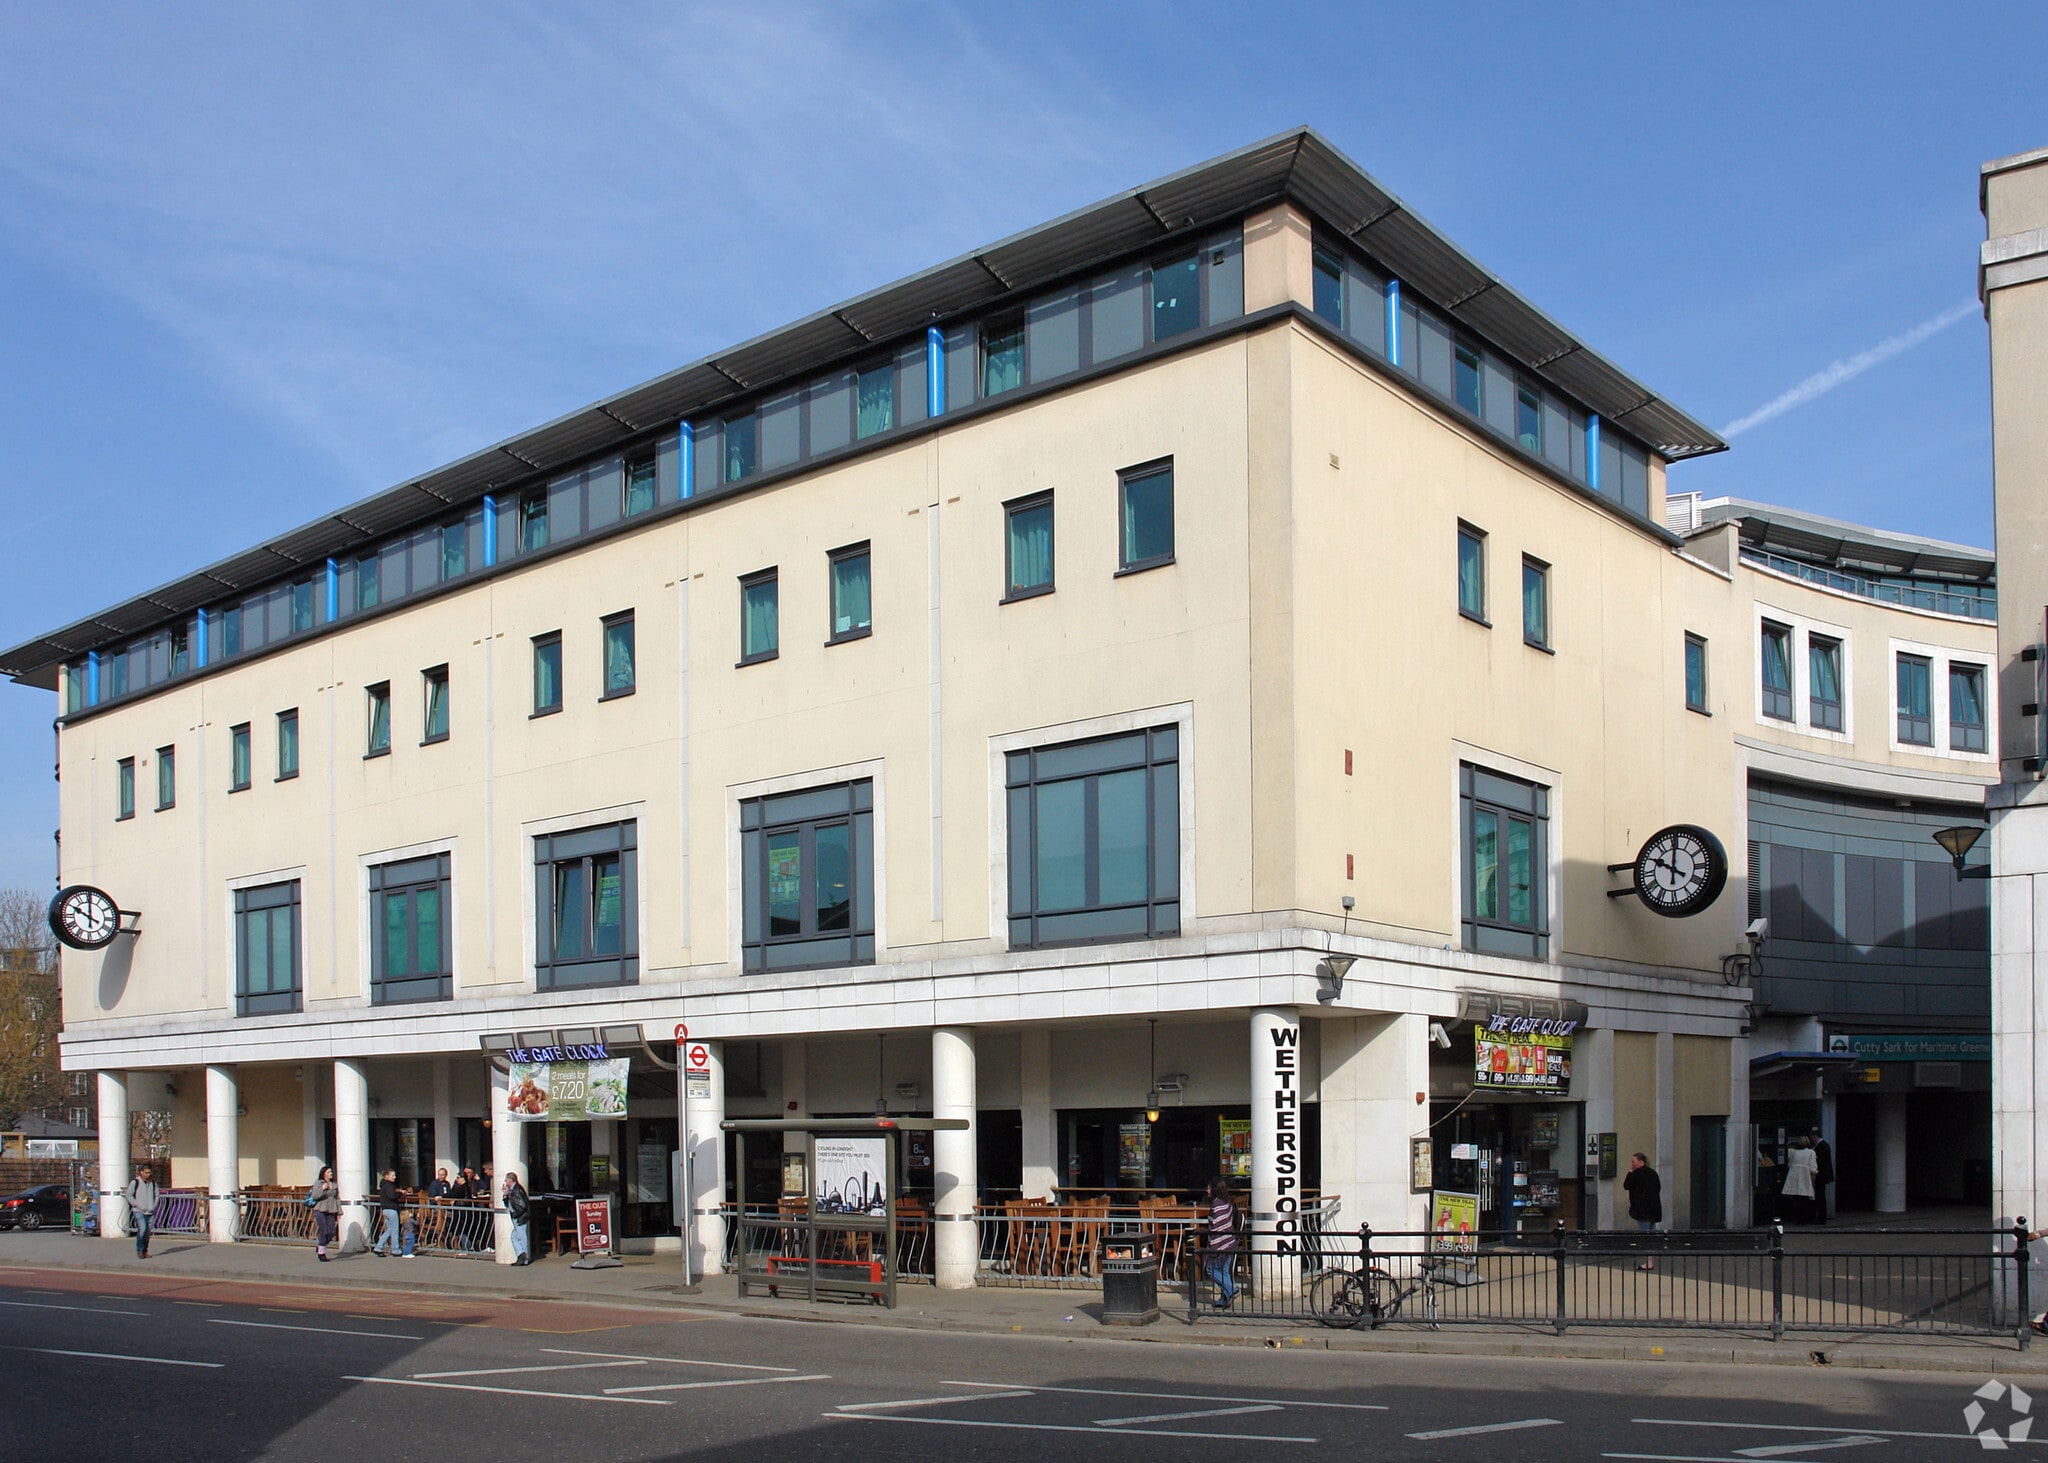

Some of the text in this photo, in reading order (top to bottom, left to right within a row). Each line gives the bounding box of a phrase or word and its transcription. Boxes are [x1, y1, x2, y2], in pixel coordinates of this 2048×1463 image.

[677, 1026, 686, 1039] A
[1488, 1014, 1577, 1036] THE GATE CLOCK
[505, 1043, 609, 1063] THE GATE CLOCK
[1854, 1041, 1881, 1055] Cutty
[1883, 1041, 1902, 1053] Sark
[1905, 1041, 1918, 1053] for
[1920, 1041, 1957, 1053] Maritime
[551, 1070, 586, 1080] 2 meals for
[552, 1081, 584, 1100] £7.20
[1270, 1027, 1298, 1258] WETHERSPOON
